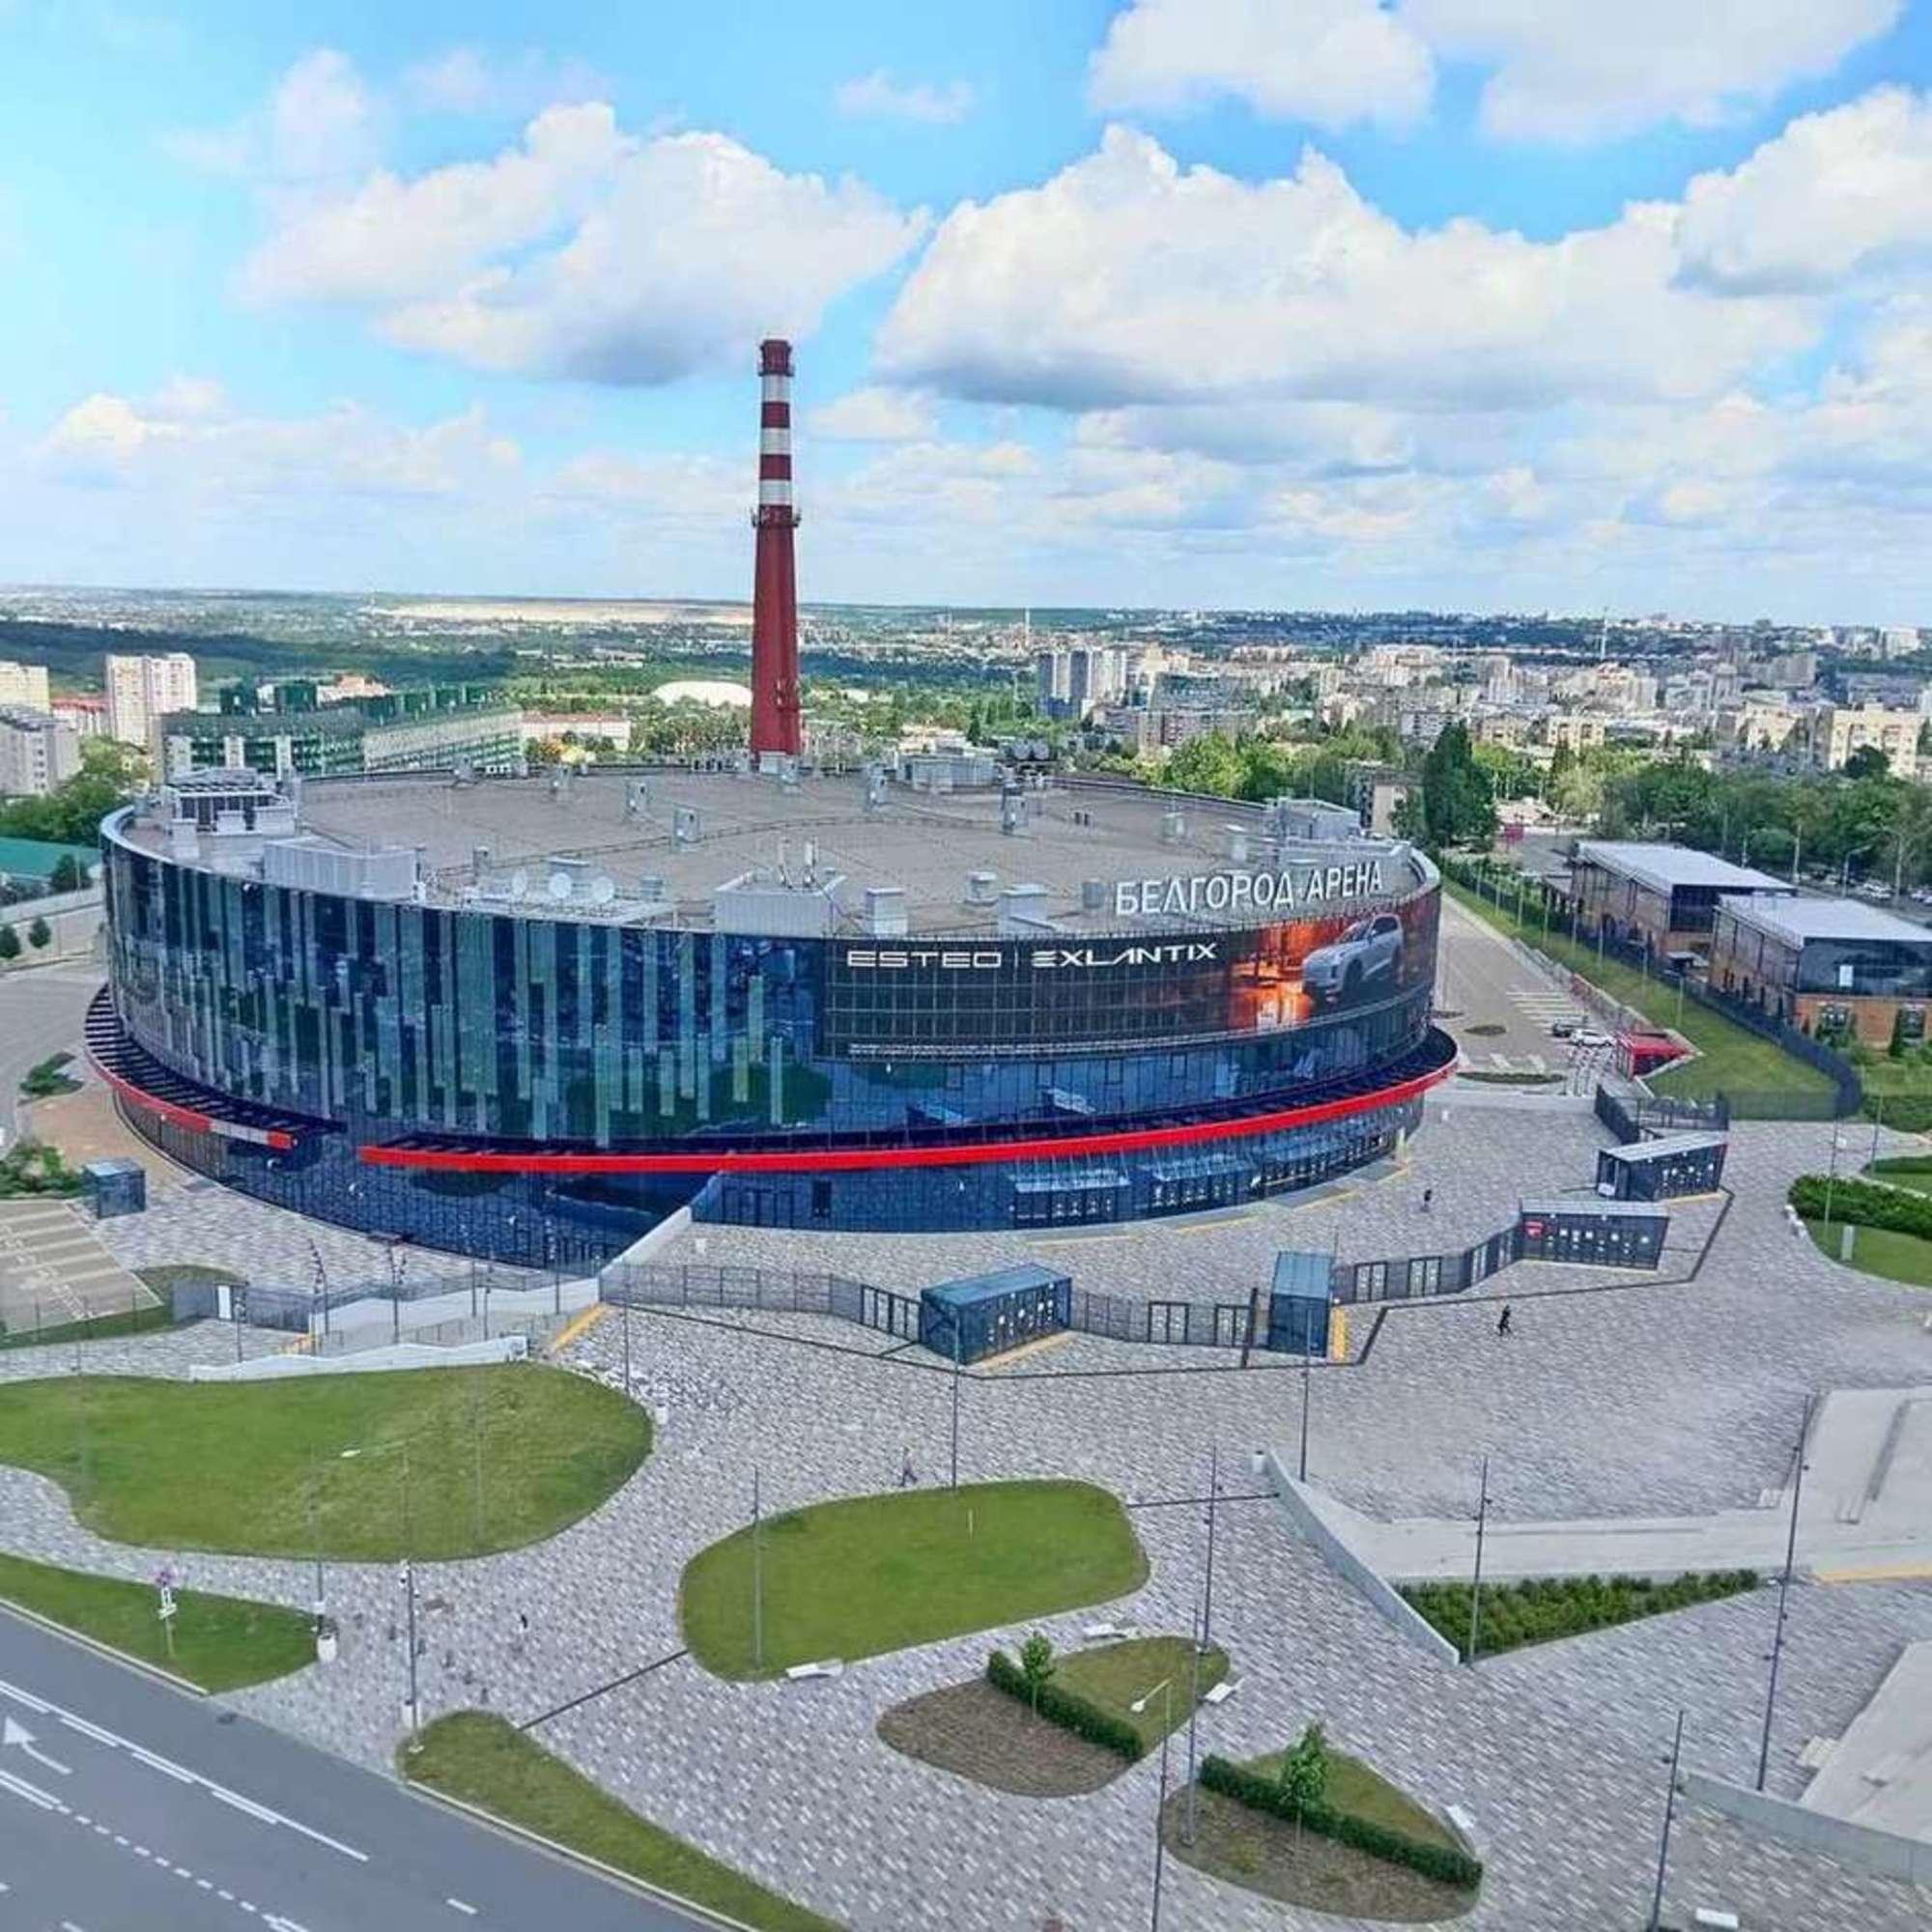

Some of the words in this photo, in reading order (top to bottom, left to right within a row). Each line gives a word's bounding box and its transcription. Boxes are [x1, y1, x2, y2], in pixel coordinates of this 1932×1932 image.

[1116, 872, 1293, 915] БЕЛГОРОД
[1306, 861, 1382, 902] АРЕНА
[847, 951, 1002, 968] ESTEO
[1031, 943, 1217, 967] EXLANTIX
